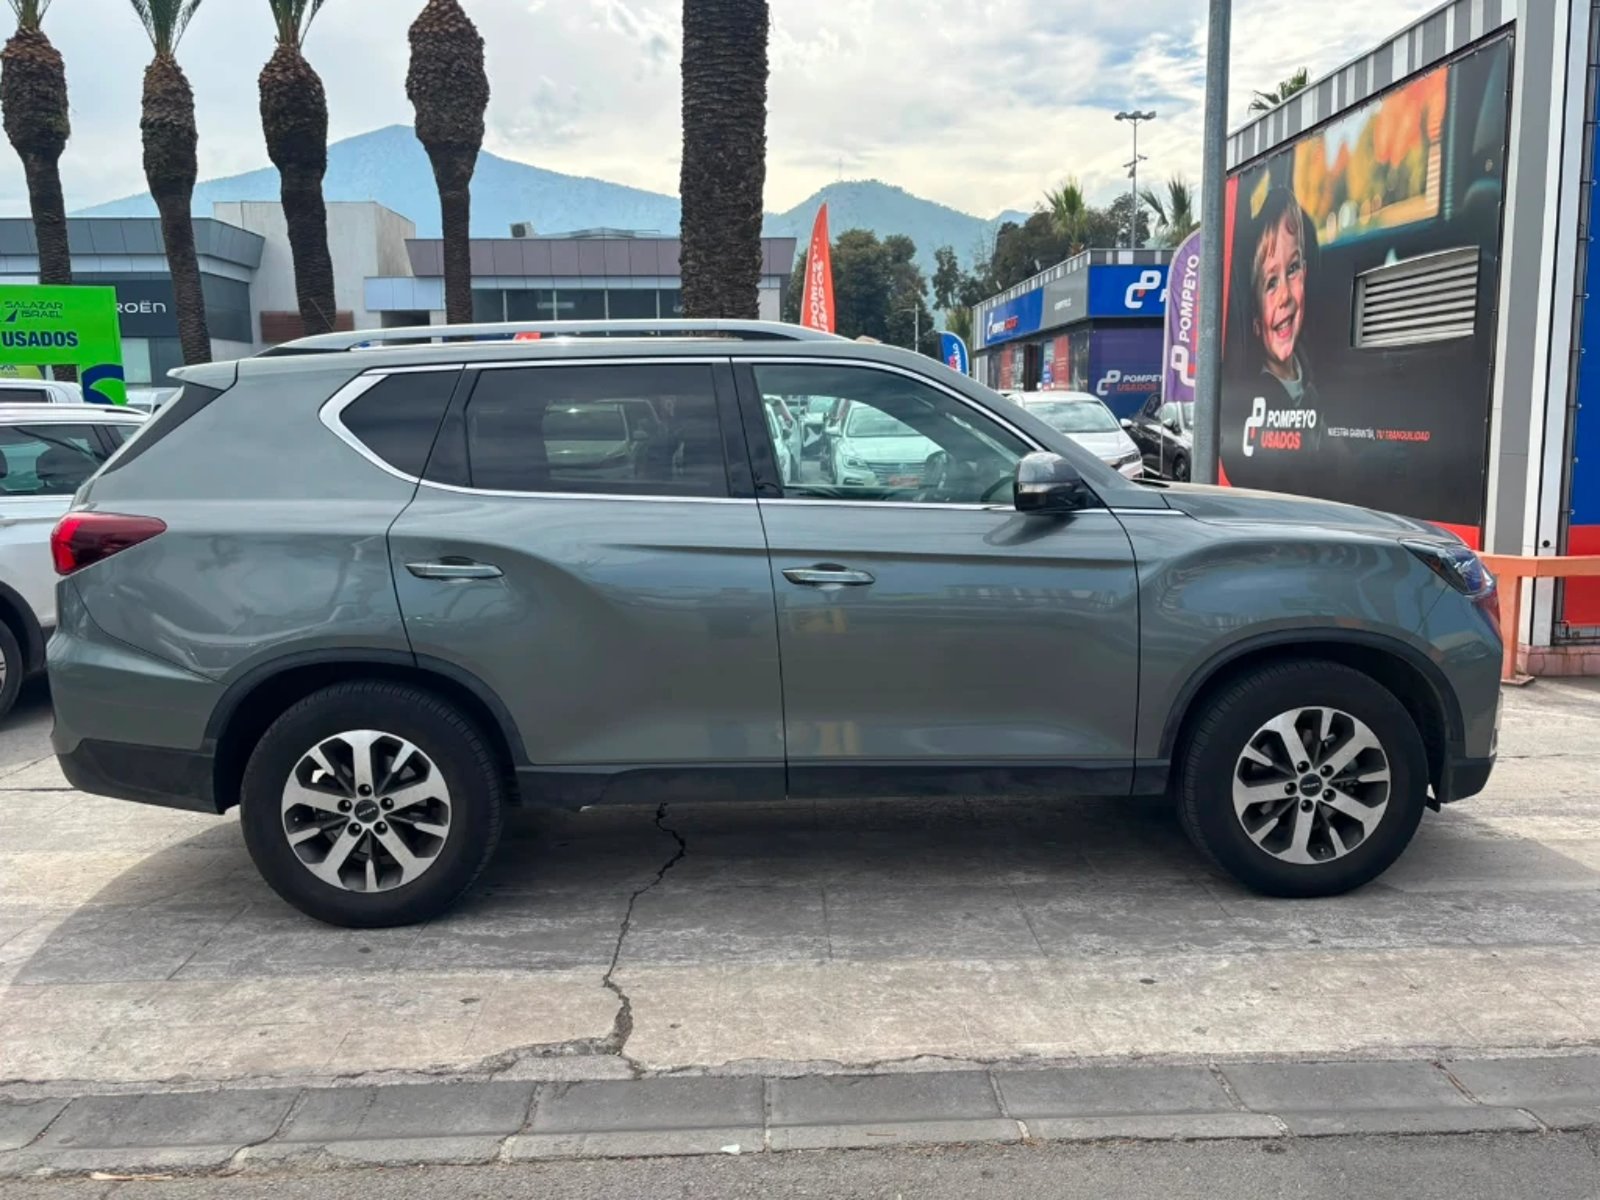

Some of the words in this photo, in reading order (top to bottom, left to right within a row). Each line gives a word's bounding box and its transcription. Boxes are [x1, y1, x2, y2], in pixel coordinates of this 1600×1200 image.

[1179, 254, 1200, 343] POMPEYO
[4, 301, 63, 310] SALAZAR
[115, 300, 167, 313] ROËN
[21, 310, 63, 319] ISRAEL
[2, 331, 78, 347] USADOS
[1123, 374, 1163, 383] POMPEY
[1117, 383, 1156, 391] USADOS
[1266, 409, 1317, 429] POMPEYO
[1261, 430, 1302, 449] USADOS
[1385, 429, 1431, 442] TRANQUILIDAD
